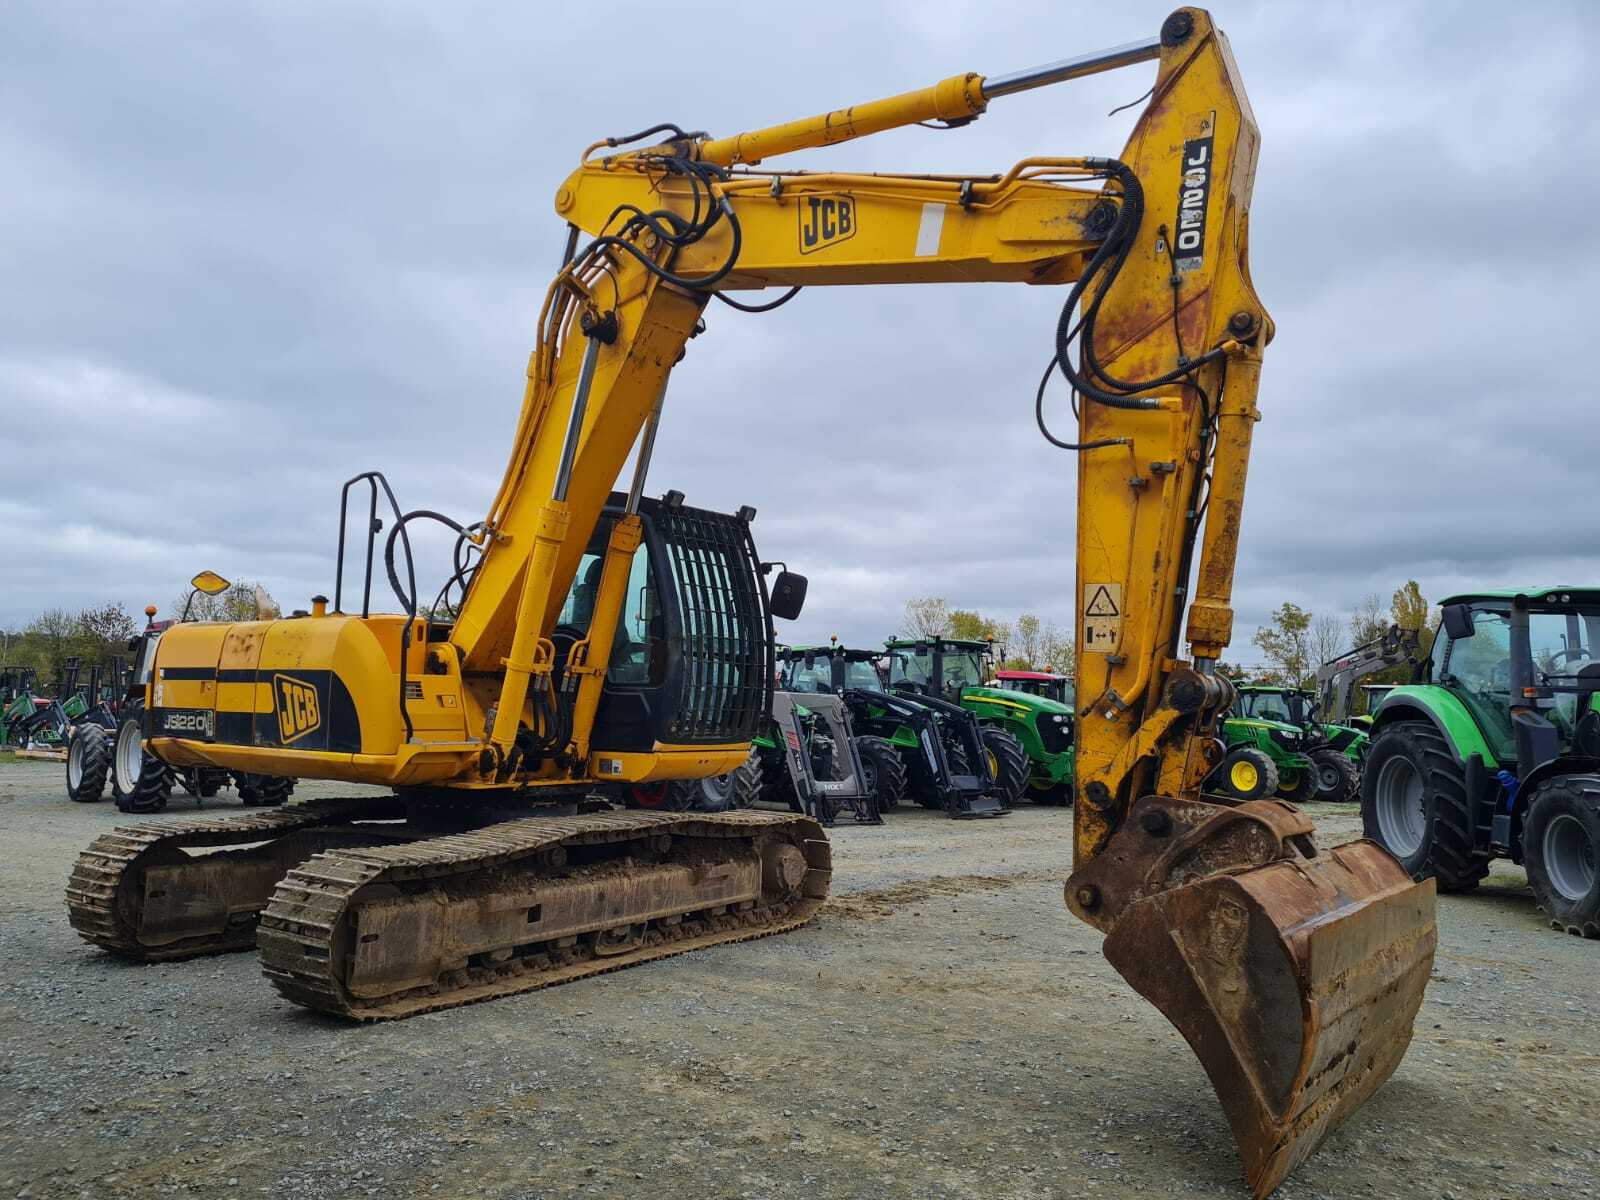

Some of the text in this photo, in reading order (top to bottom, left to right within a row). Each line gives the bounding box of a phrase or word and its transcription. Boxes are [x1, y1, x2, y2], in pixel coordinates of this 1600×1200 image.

[804, 196, 851, 247] JCB
[163, 714, 205, 730] JS220
[281, 682, 318, 736] JCB
